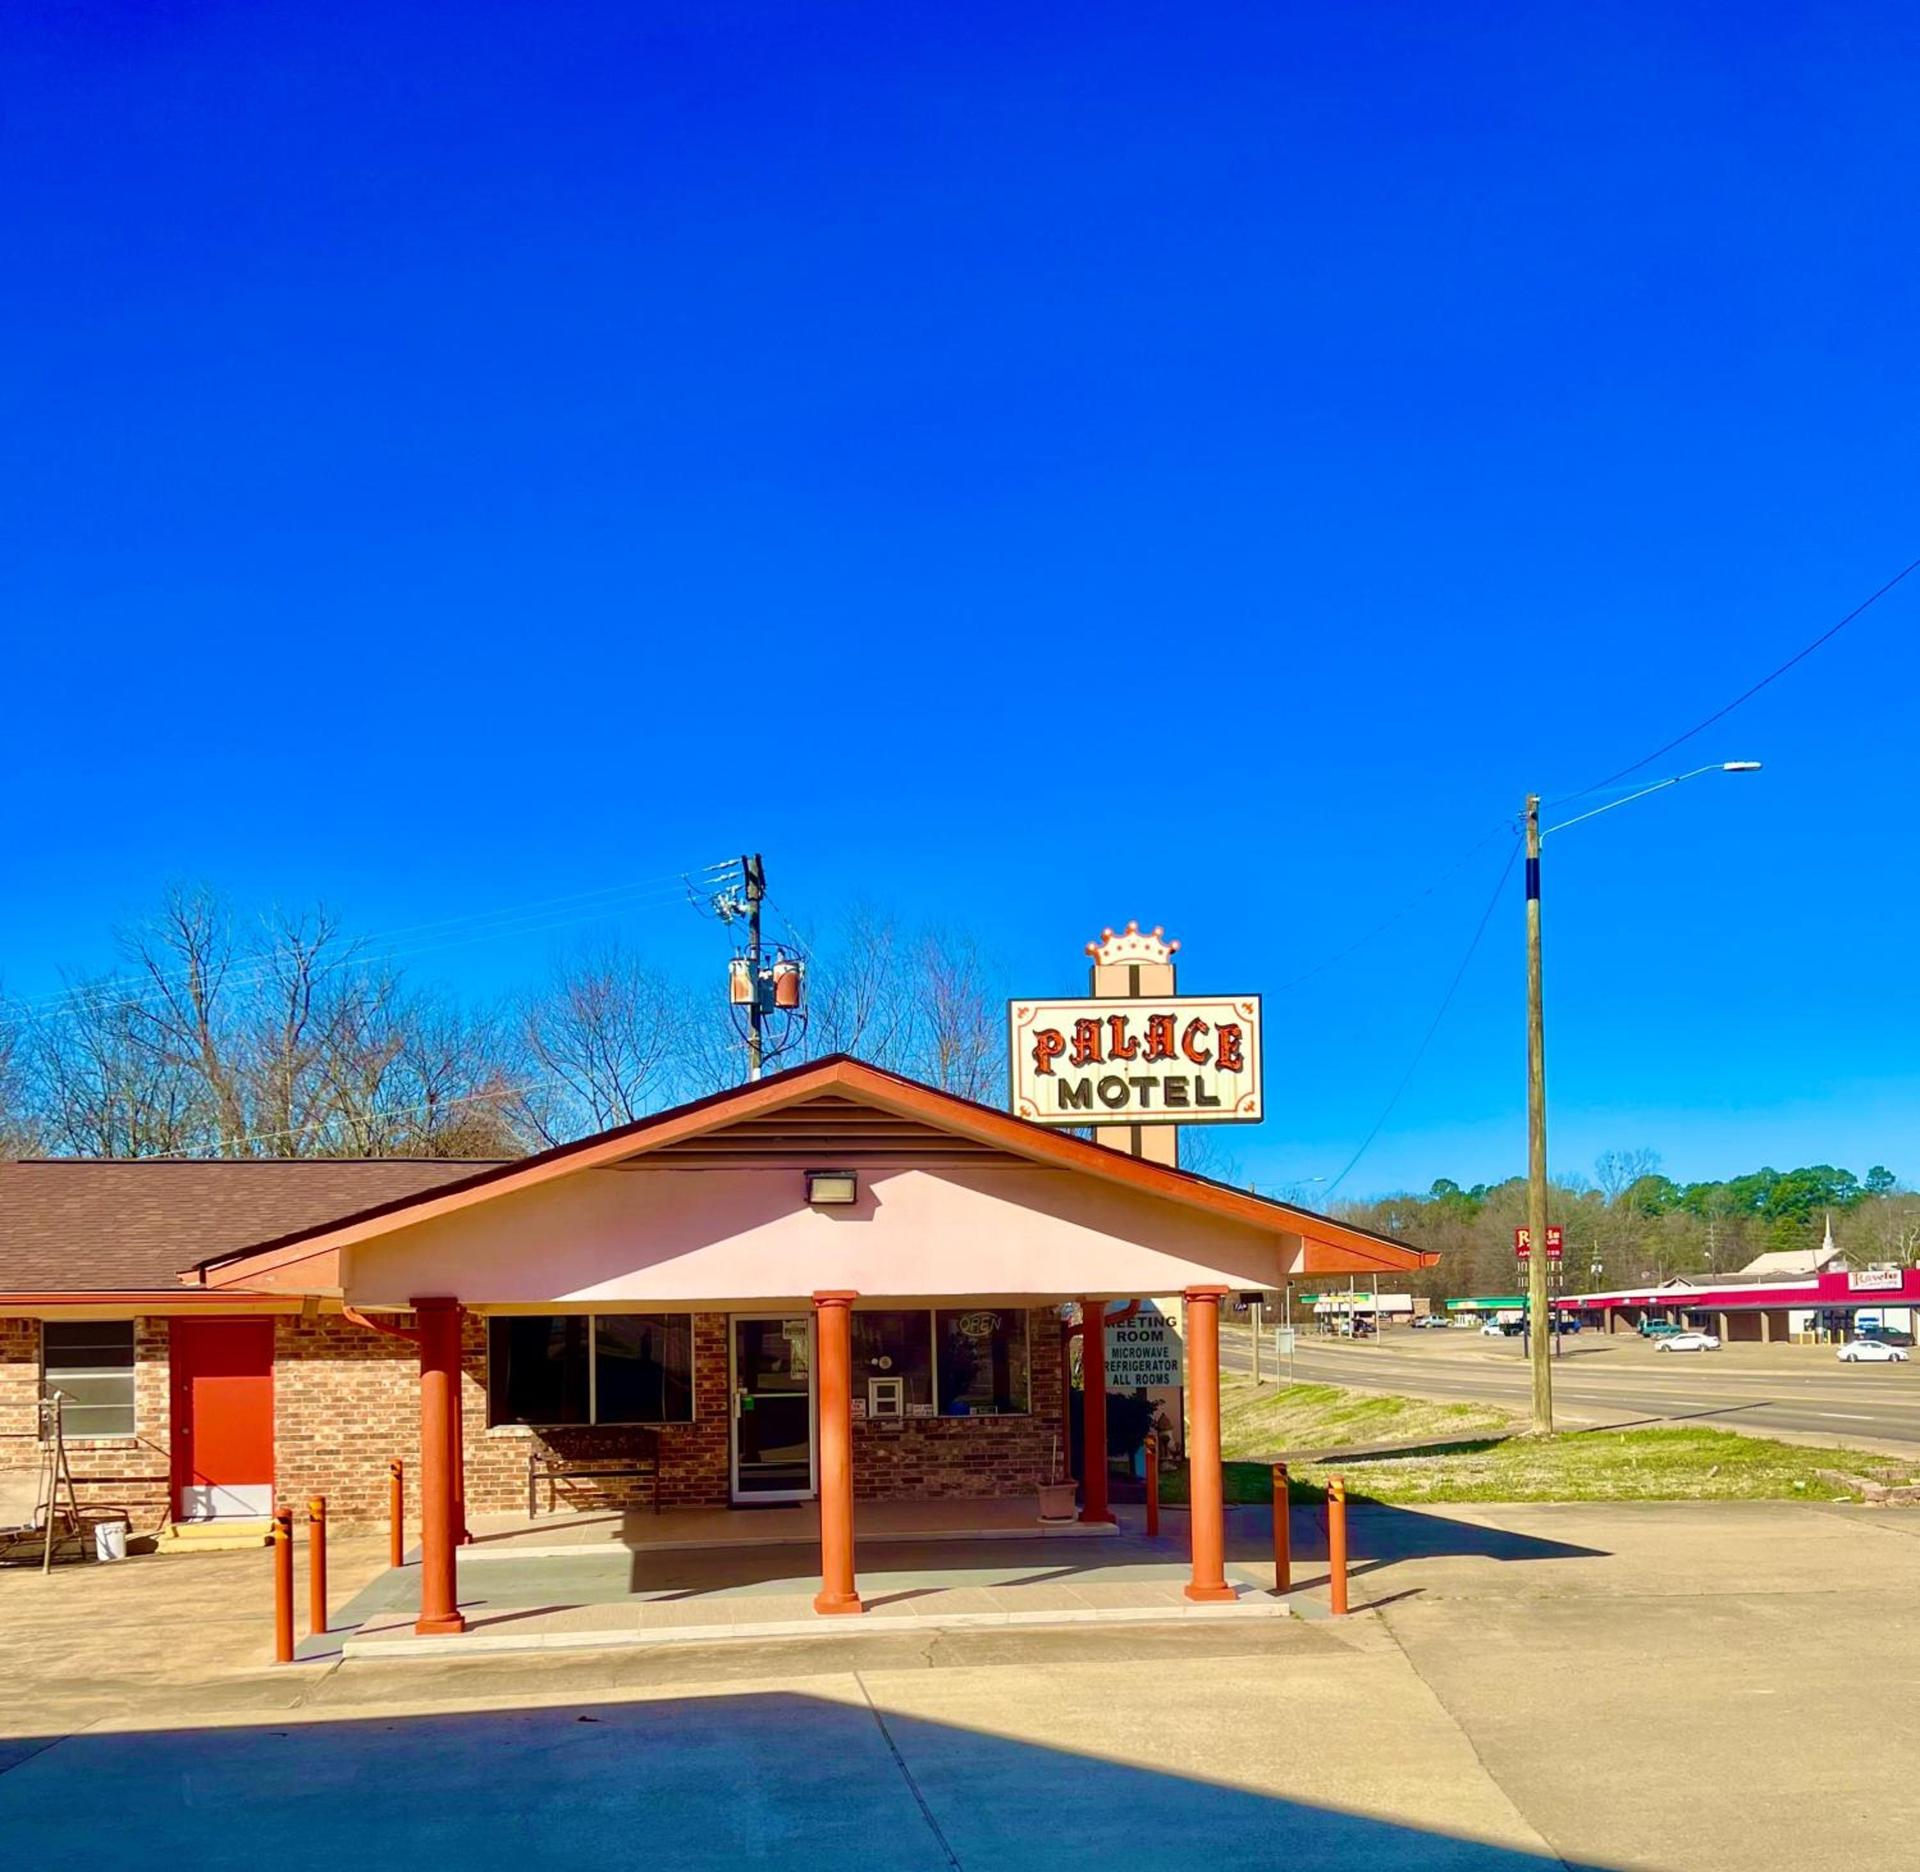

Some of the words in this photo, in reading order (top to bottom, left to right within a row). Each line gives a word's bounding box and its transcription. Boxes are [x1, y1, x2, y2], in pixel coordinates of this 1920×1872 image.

[1032, 1013, 1245, 1077] PALACE
[1058, 1074, 1221, 1110] MOTEL
[959, 1316, 1003, 1333] OPEN
[1116, 1330, 1164, 1343] ROOM
[1111, 1346, 1169, 1358] MICROWAVE
[1113, 1374, 1131, 1386] ALL
[1135, 1373, 1170, 1385] ROOMS
